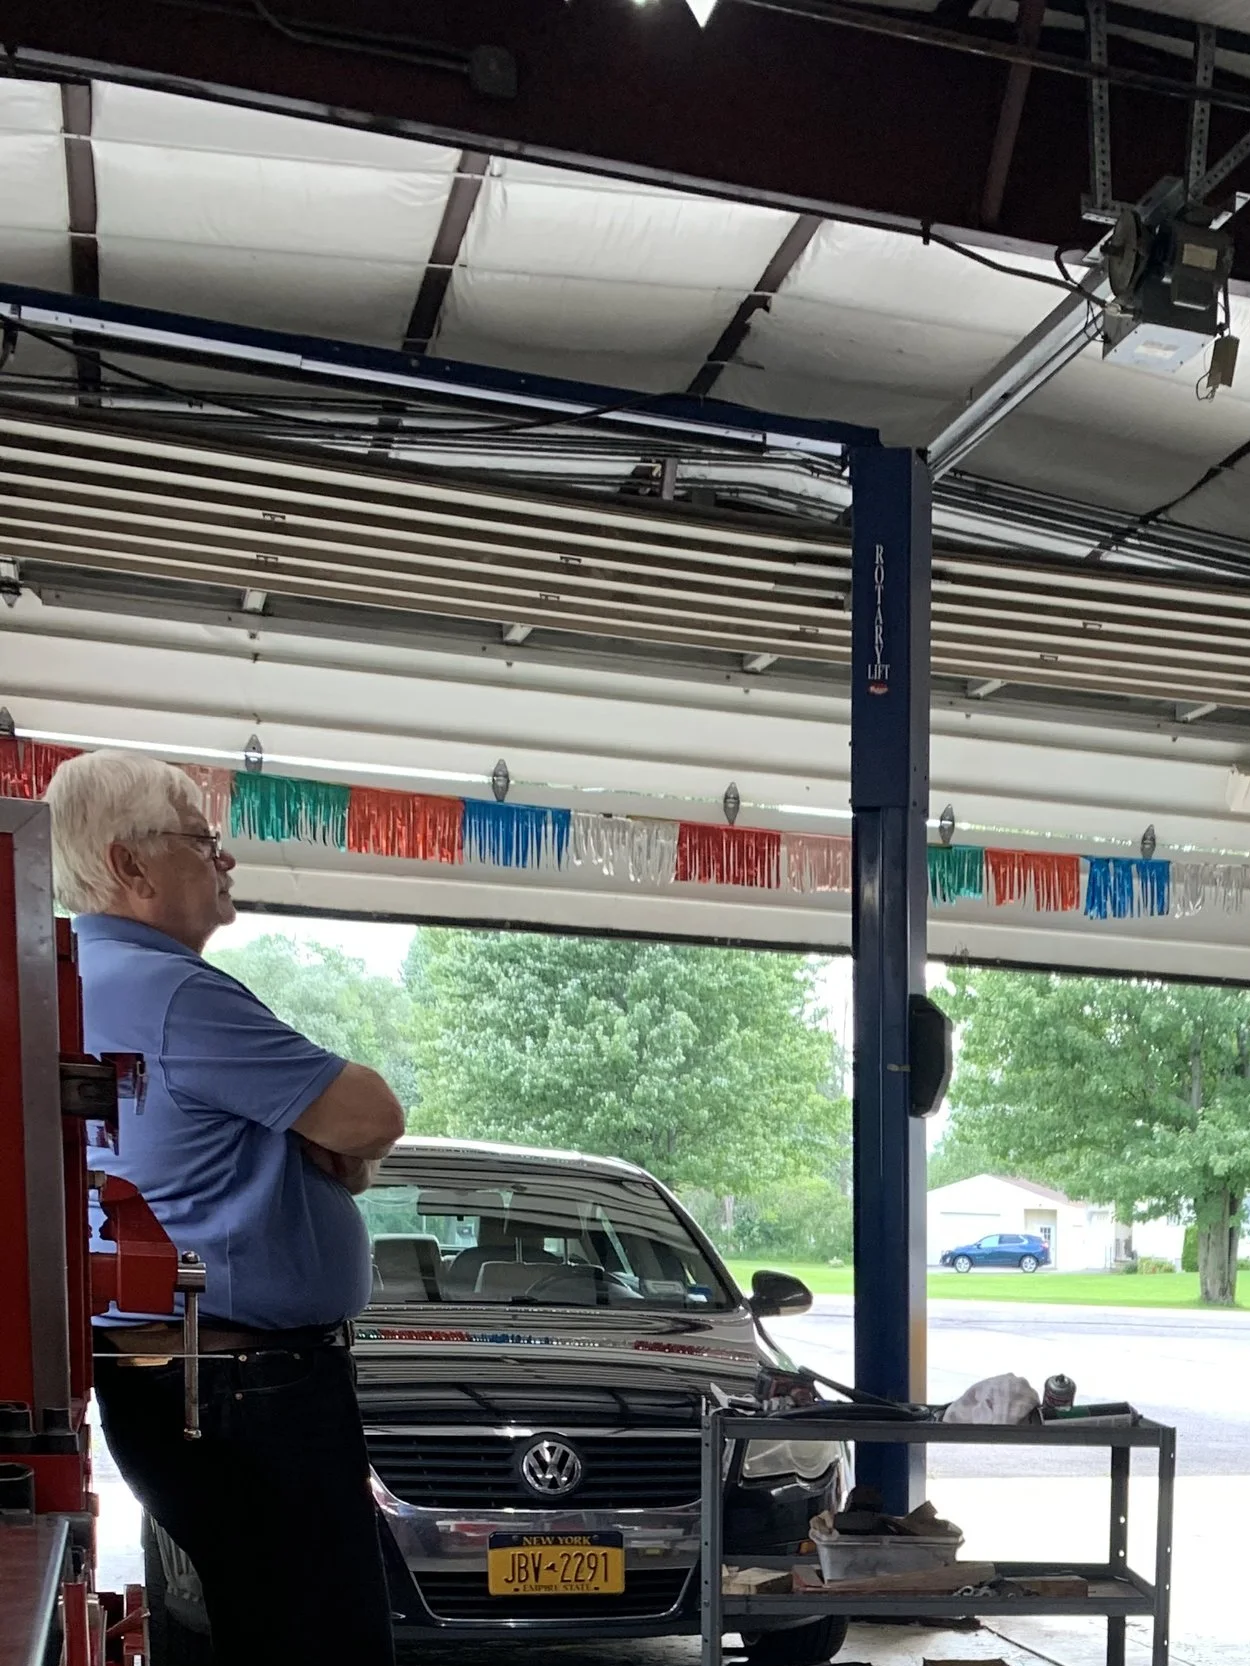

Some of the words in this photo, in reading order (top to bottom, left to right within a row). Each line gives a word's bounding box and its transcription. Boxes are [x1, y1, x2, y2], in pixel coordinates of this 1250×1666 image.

[874, 544, 885, 664] ROTARY
[867, 664, 891, 680] LIFT
[522, 1536, 555, 1546] NEW
[558, 1535, 591, 1545] YORK
[504, 1551, 542, 1583] JBV
[559, 1551, 609, 1583] 2291
[522, 1583, 558, 1593] EMPIRE
[563, 1582, 591, 1592] STATE
